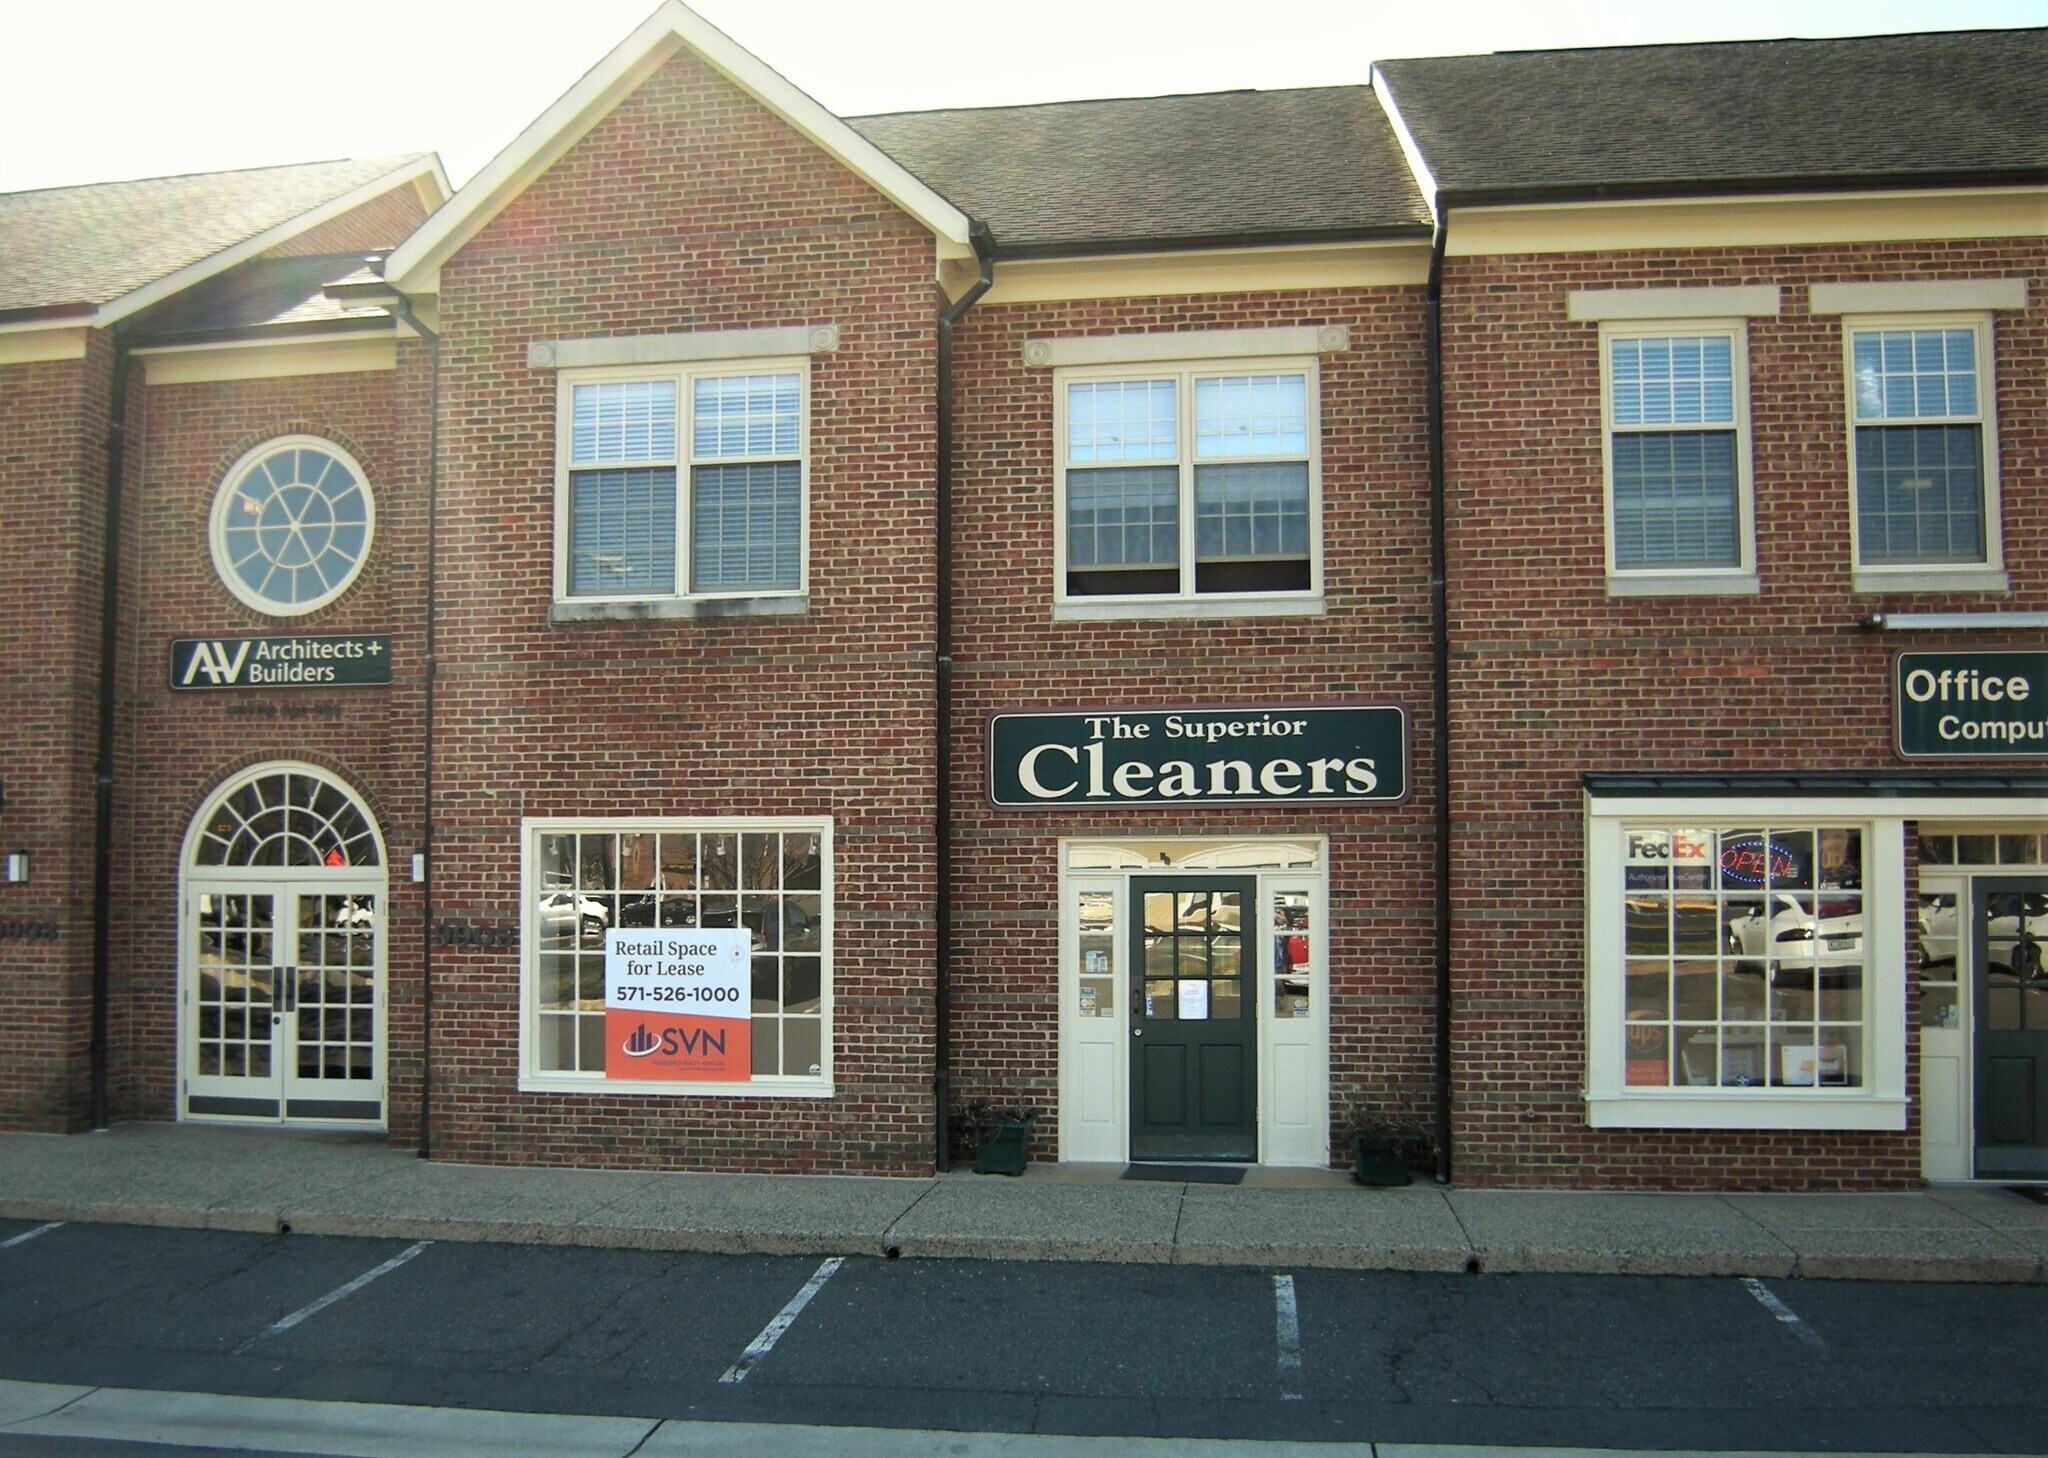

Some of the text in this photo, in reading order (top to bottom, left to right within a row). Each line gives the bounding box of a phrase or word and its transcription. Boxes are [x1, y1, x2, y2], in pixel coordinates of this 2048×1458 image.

[182, 641, 251, 684] AV
[256, 640, 364, 660] Architects
[250, 662, 335, 683] Builders
[1905, 669, 2030, 702] Office
[1085, 714, 1307, 743] The Superior
[1938, 715, 2048, 744] Compu
[1018, 742, 1377, 799] Cleaners
[1629, 835, 1705, 859] FedEx
[1719, 849, 1792, 877] OPEN
[434, 924, 514, 948] 9905
[615, 941, 717, 960] Retail Space
[627, 960, 705, 976] for Lease
[617, 987, 740, 1002] 571-526-1000
[662, 1027, 725, 1056] SVN
